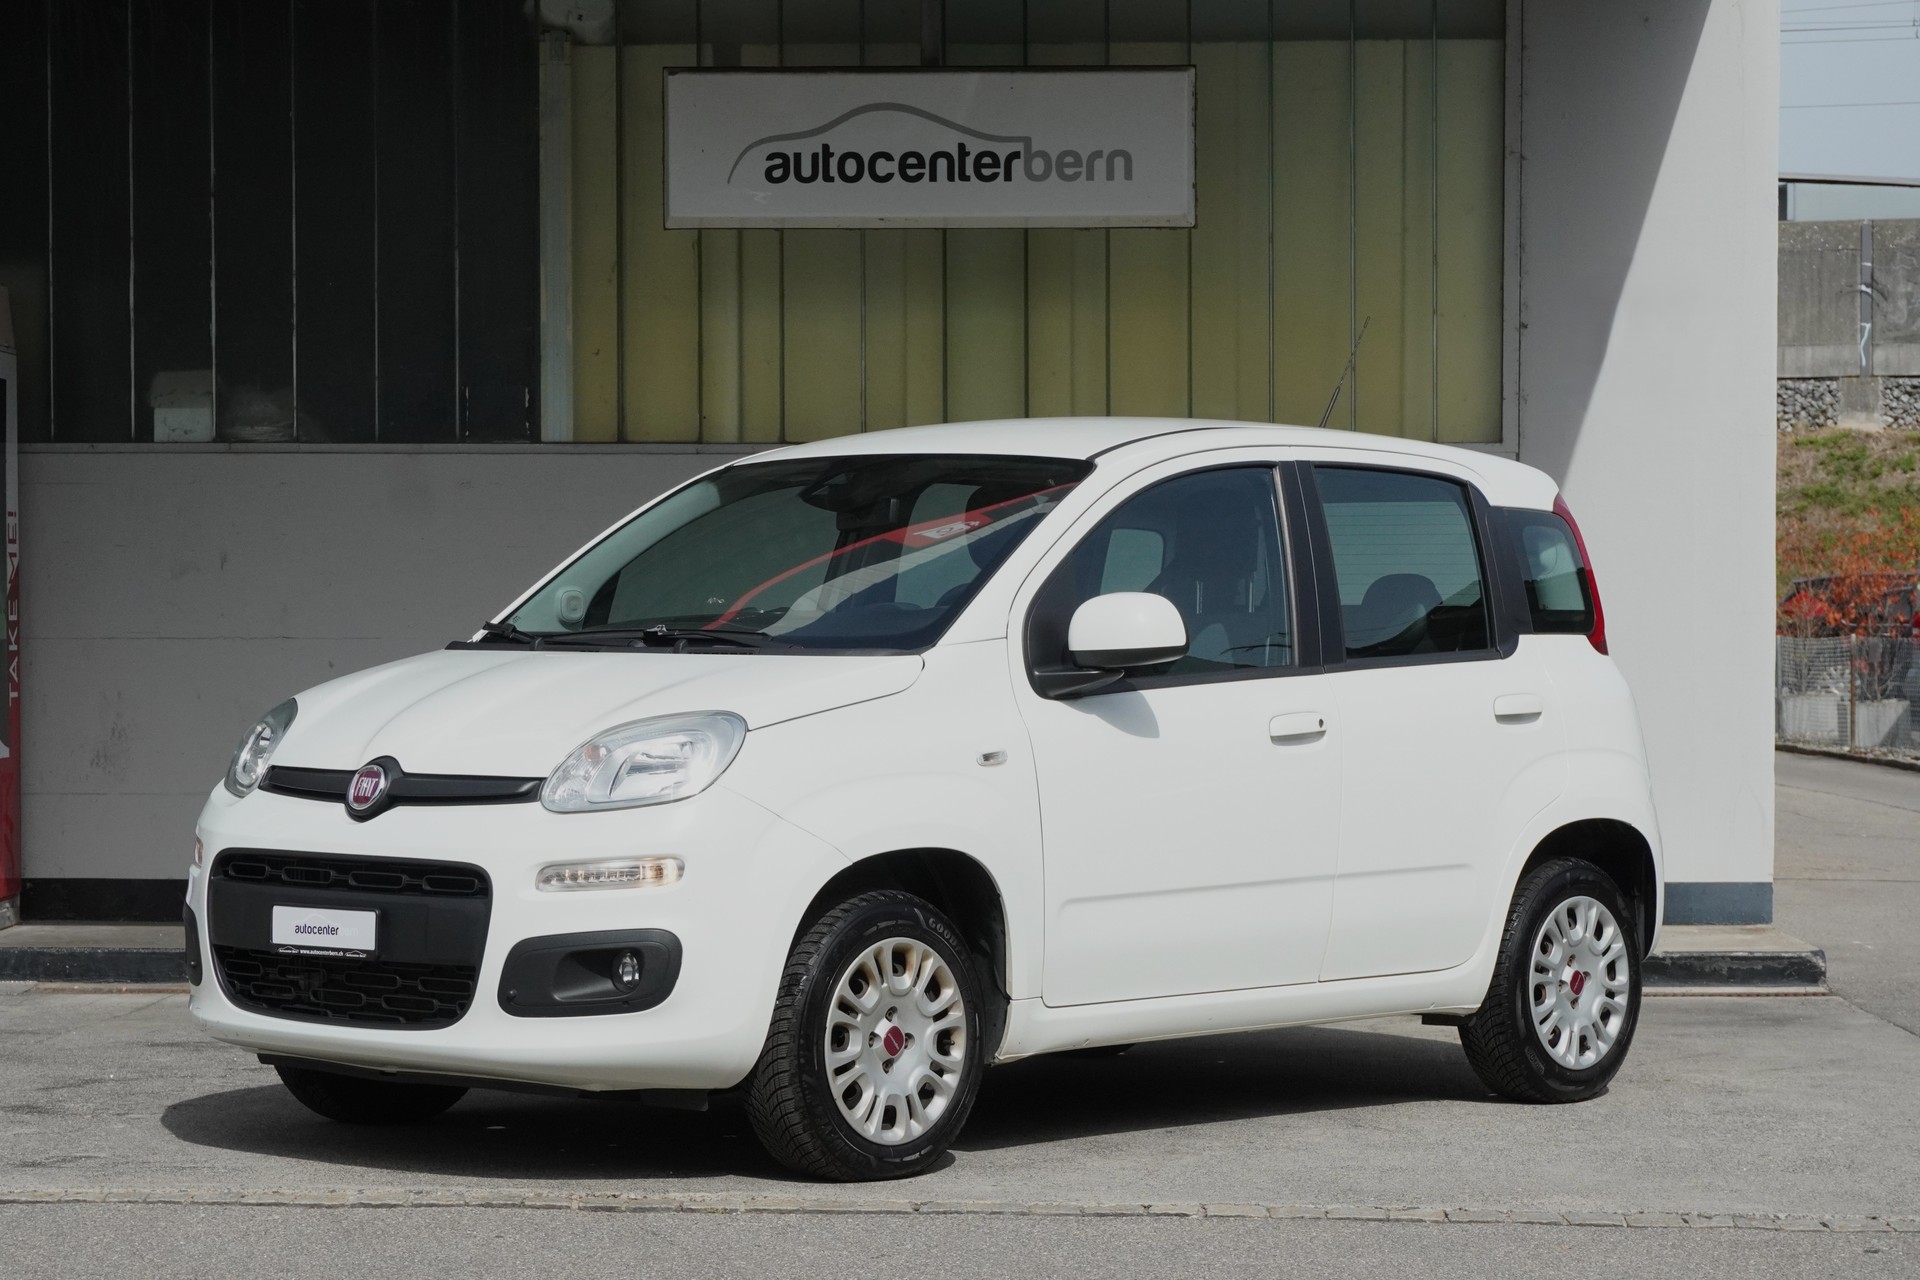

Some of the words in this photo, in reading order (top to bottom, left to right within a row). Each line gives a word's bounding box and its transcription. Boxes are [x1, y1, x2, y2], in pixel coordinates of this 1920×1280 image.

[764, 137, 1133, 184] autocenterbern
[7, 511, 18, 585] ME!
[8, 599, 19, 707] TAKE
[354, 776, 379, 798] FIAT
[299, 948, 344, 957] www.autocenterbern.ch
